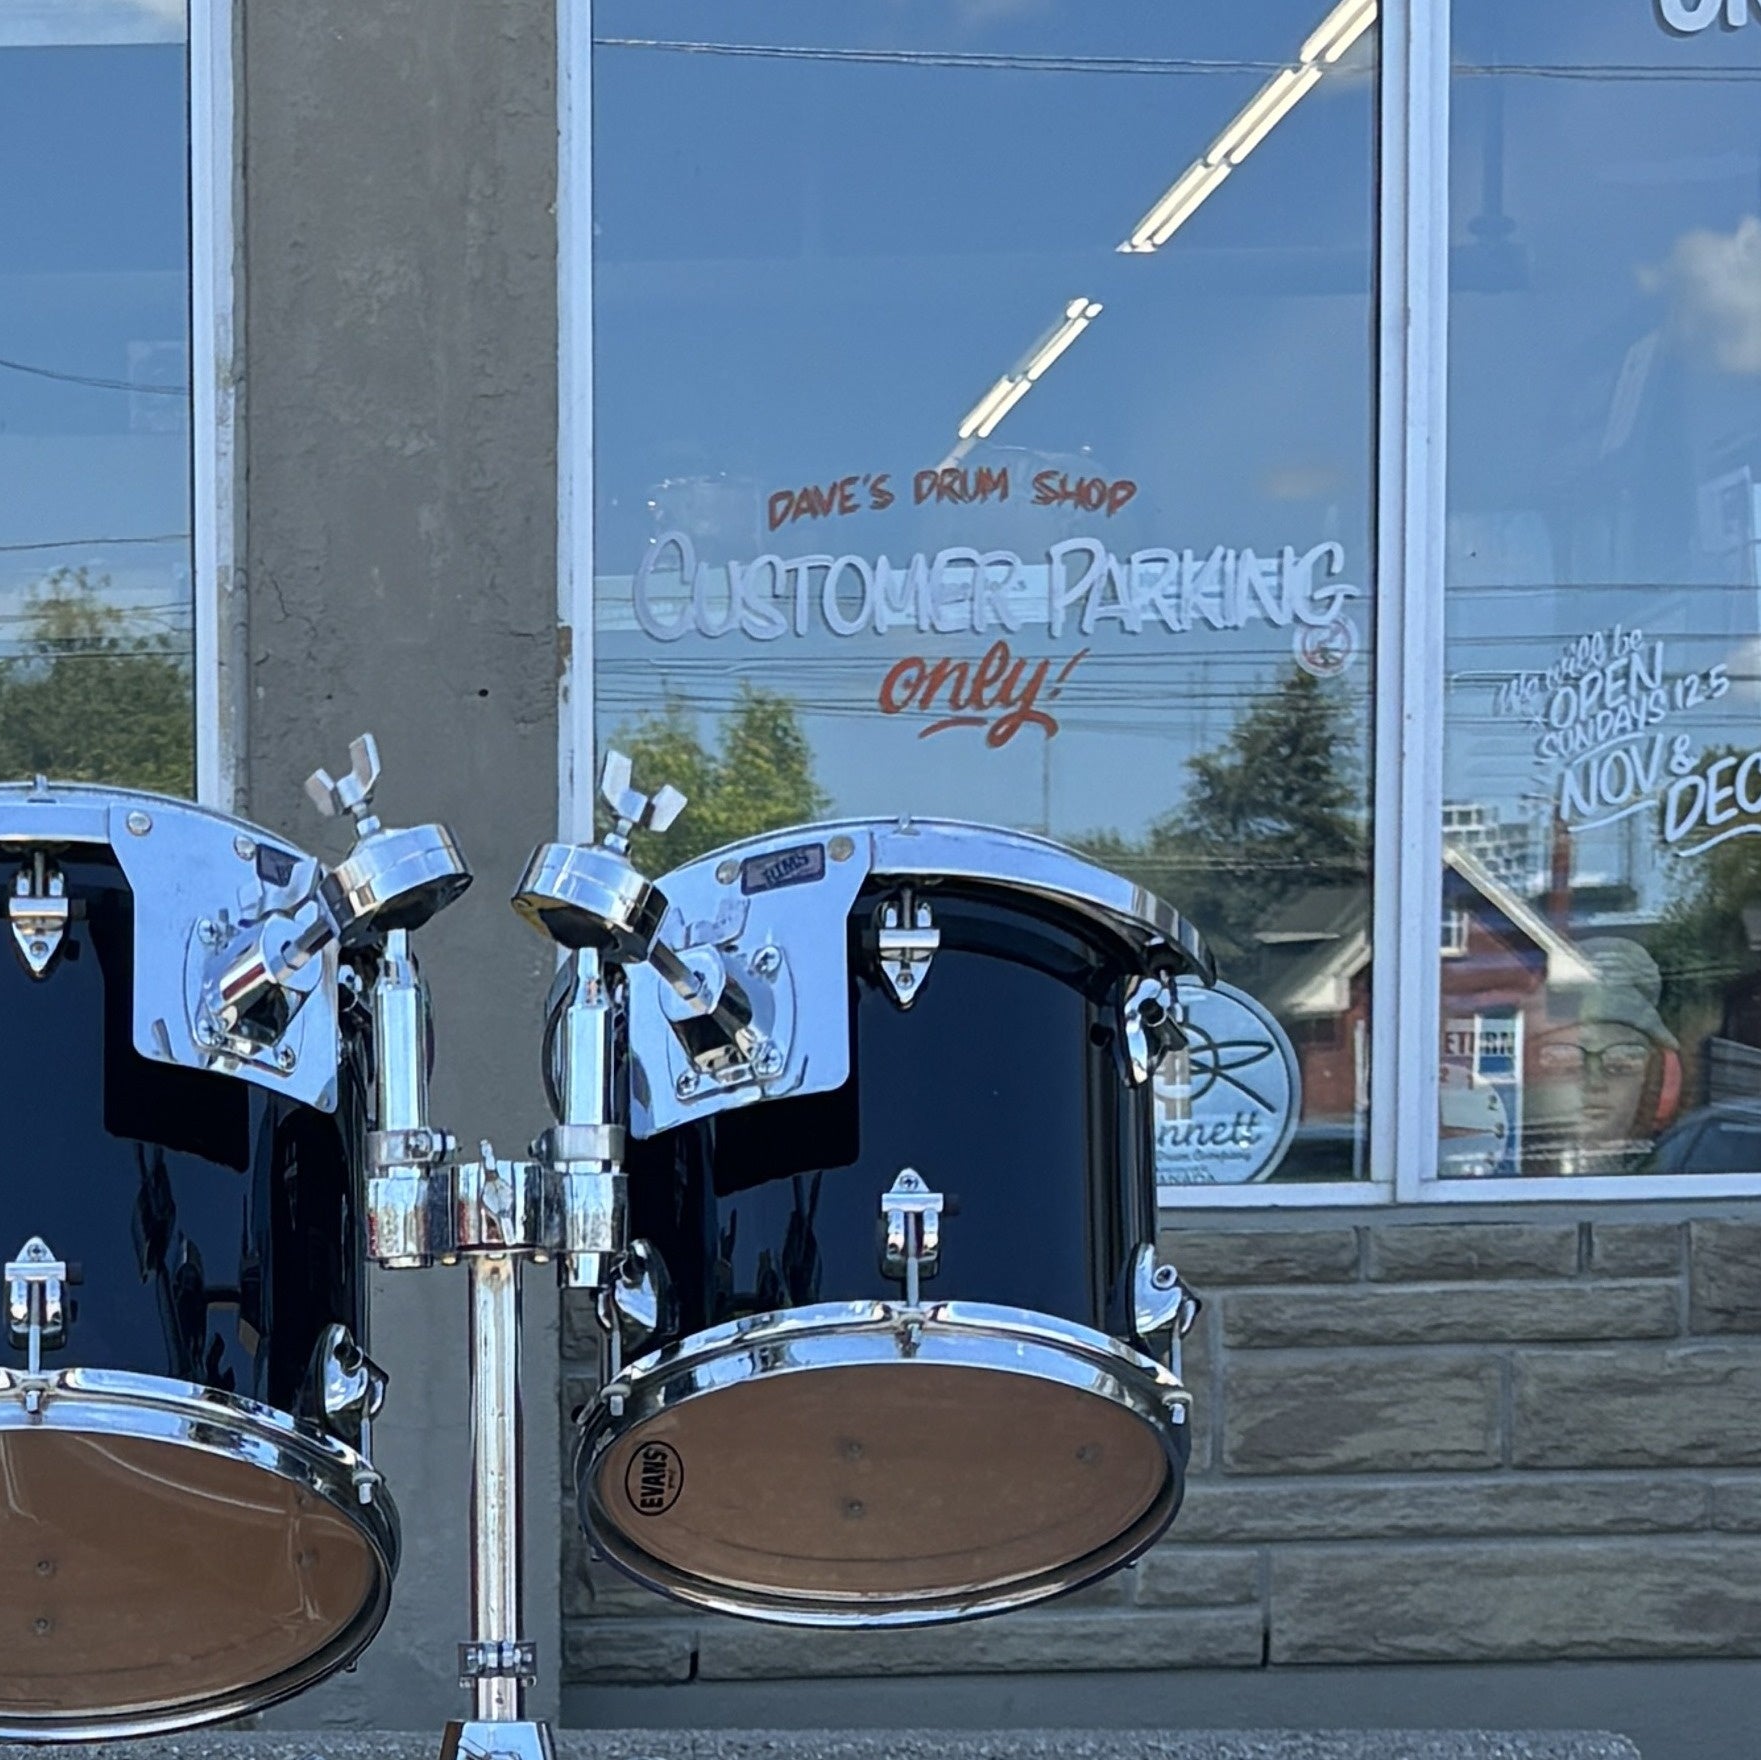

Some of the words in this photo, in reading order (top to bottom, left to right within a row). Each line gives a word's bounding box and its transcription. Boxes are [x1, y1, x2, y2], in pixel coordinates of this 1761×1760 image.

[768, 472, 895, 532] DAVE'S
[912, 465, 1009, 505] DRUM
[1030, 469, 1137, 518] SHOP
[633, 530, 1026, 642] CUSTOMER
[1045, 537, 1360, 639] PARKING
[1612, 623, 1645, 658] be
[878, 639, 1091, 748] only!
[1540, 689, 1667, 758] SUNDAYS
[1548, 640, 1664, 729] OPEN
[1559, 732, 1664, 822] NOV
[1669, 733, 1699, 775] &
[640, 1447, 669, 1508] EVANS
